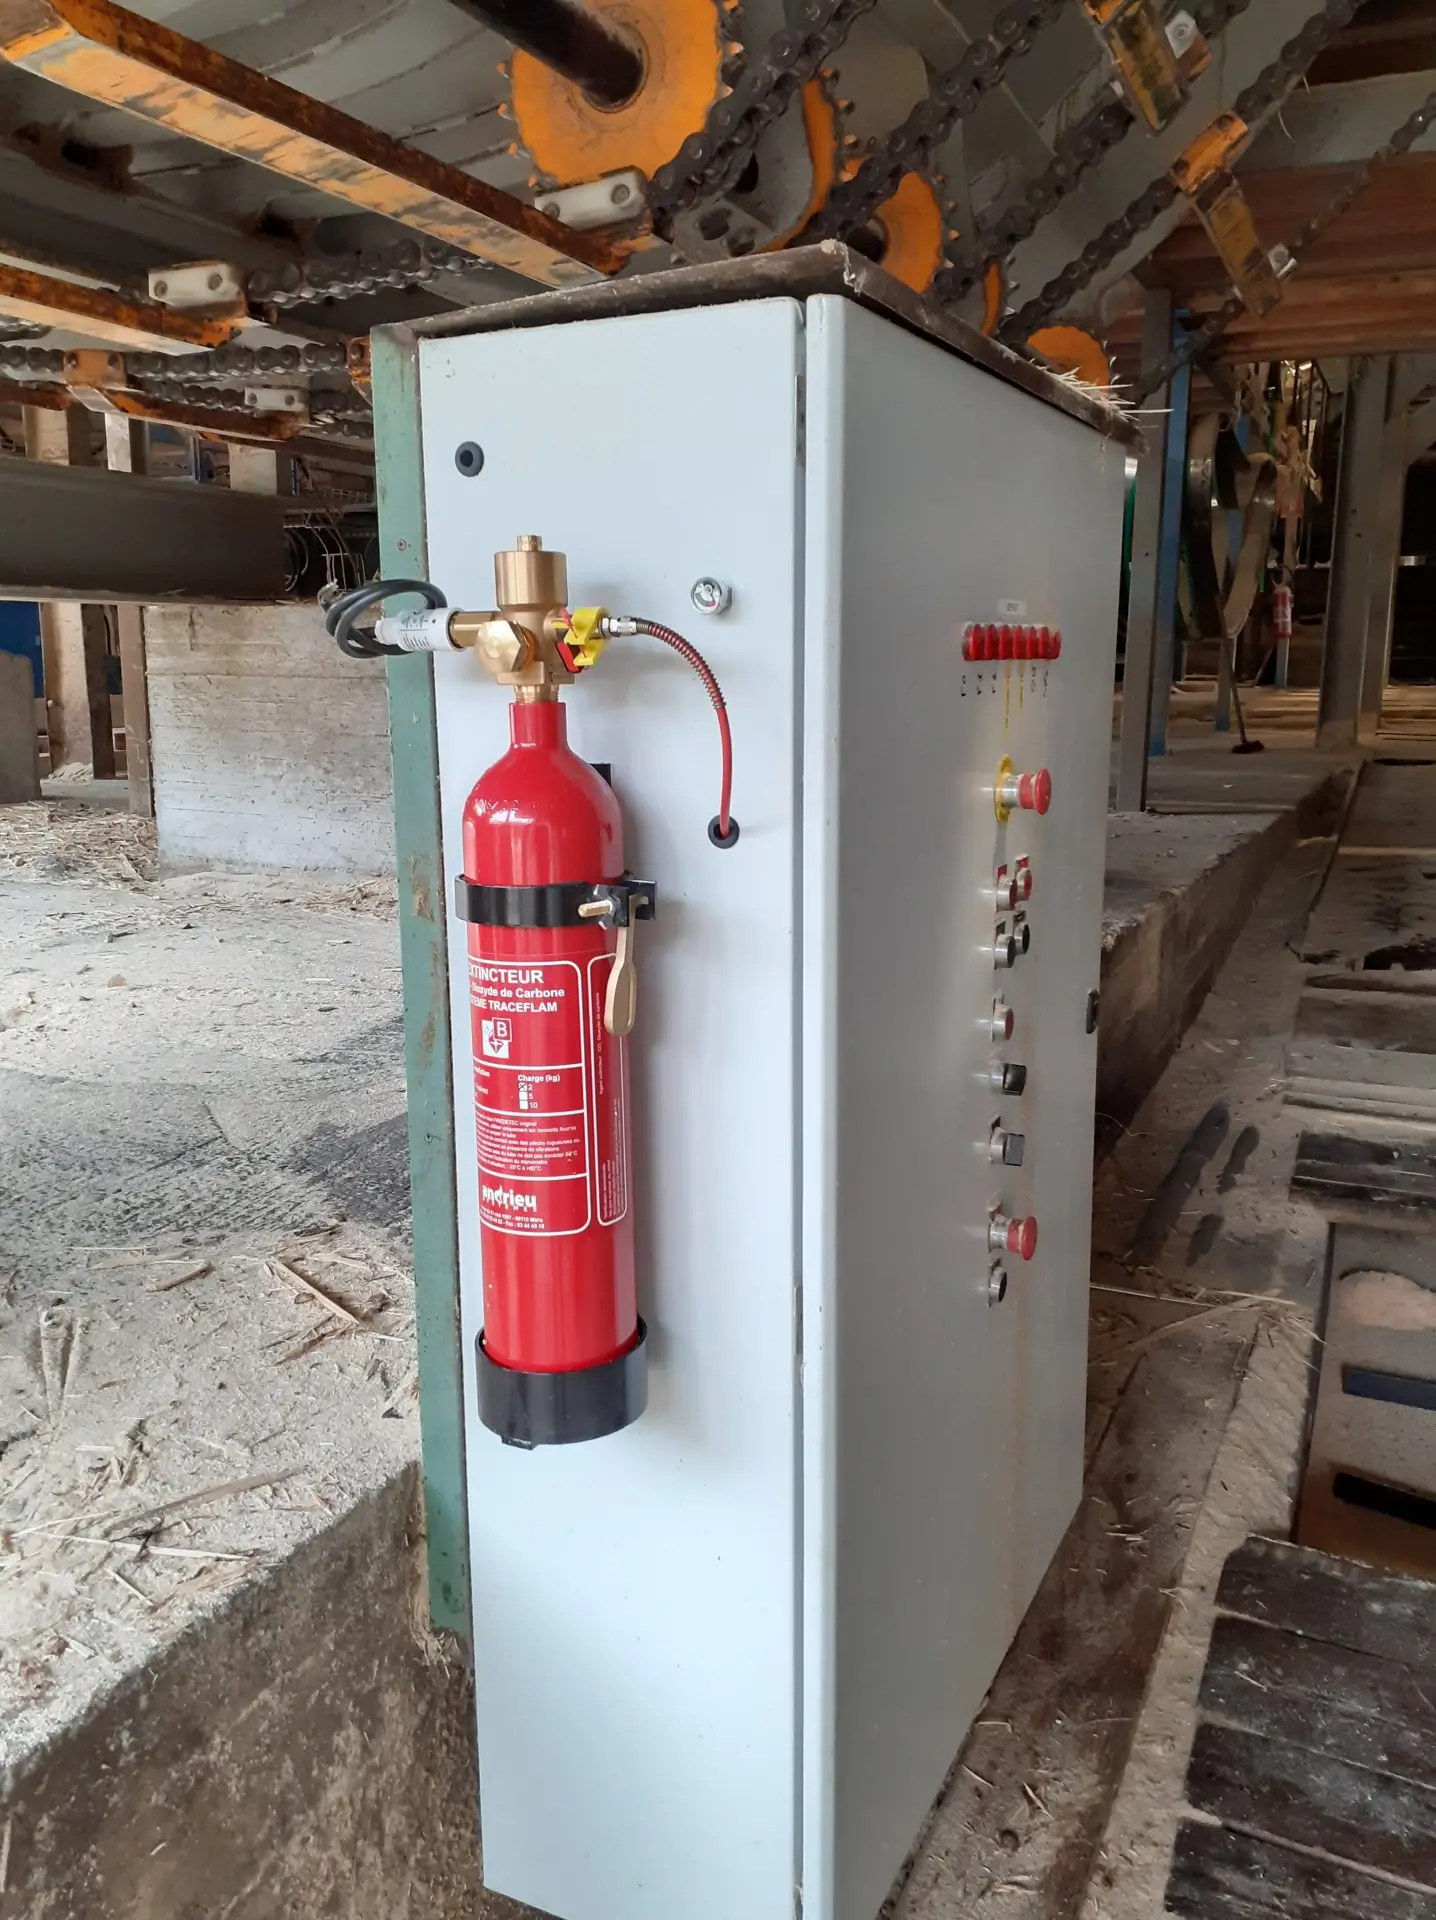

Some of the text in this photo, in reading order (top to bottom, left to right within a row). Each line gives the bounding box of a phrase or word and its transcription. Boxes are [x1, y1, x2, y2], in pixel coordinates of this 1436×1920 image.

[500, 987, 513, 998] de
[515, 987, 565, 999] Carbone
[488, 999, 557, 1012] TRACEFLAM
[496, 1021, 507, 1037] B
[517, 1074, 561, 1083] Charge (kg)
[528, 1083, 533, 1091] 2
[528, 1092, 534, 1100] 5
[529, 1101, 539, 1109] 10
[482, 1184, 537, 1212] andrieu
